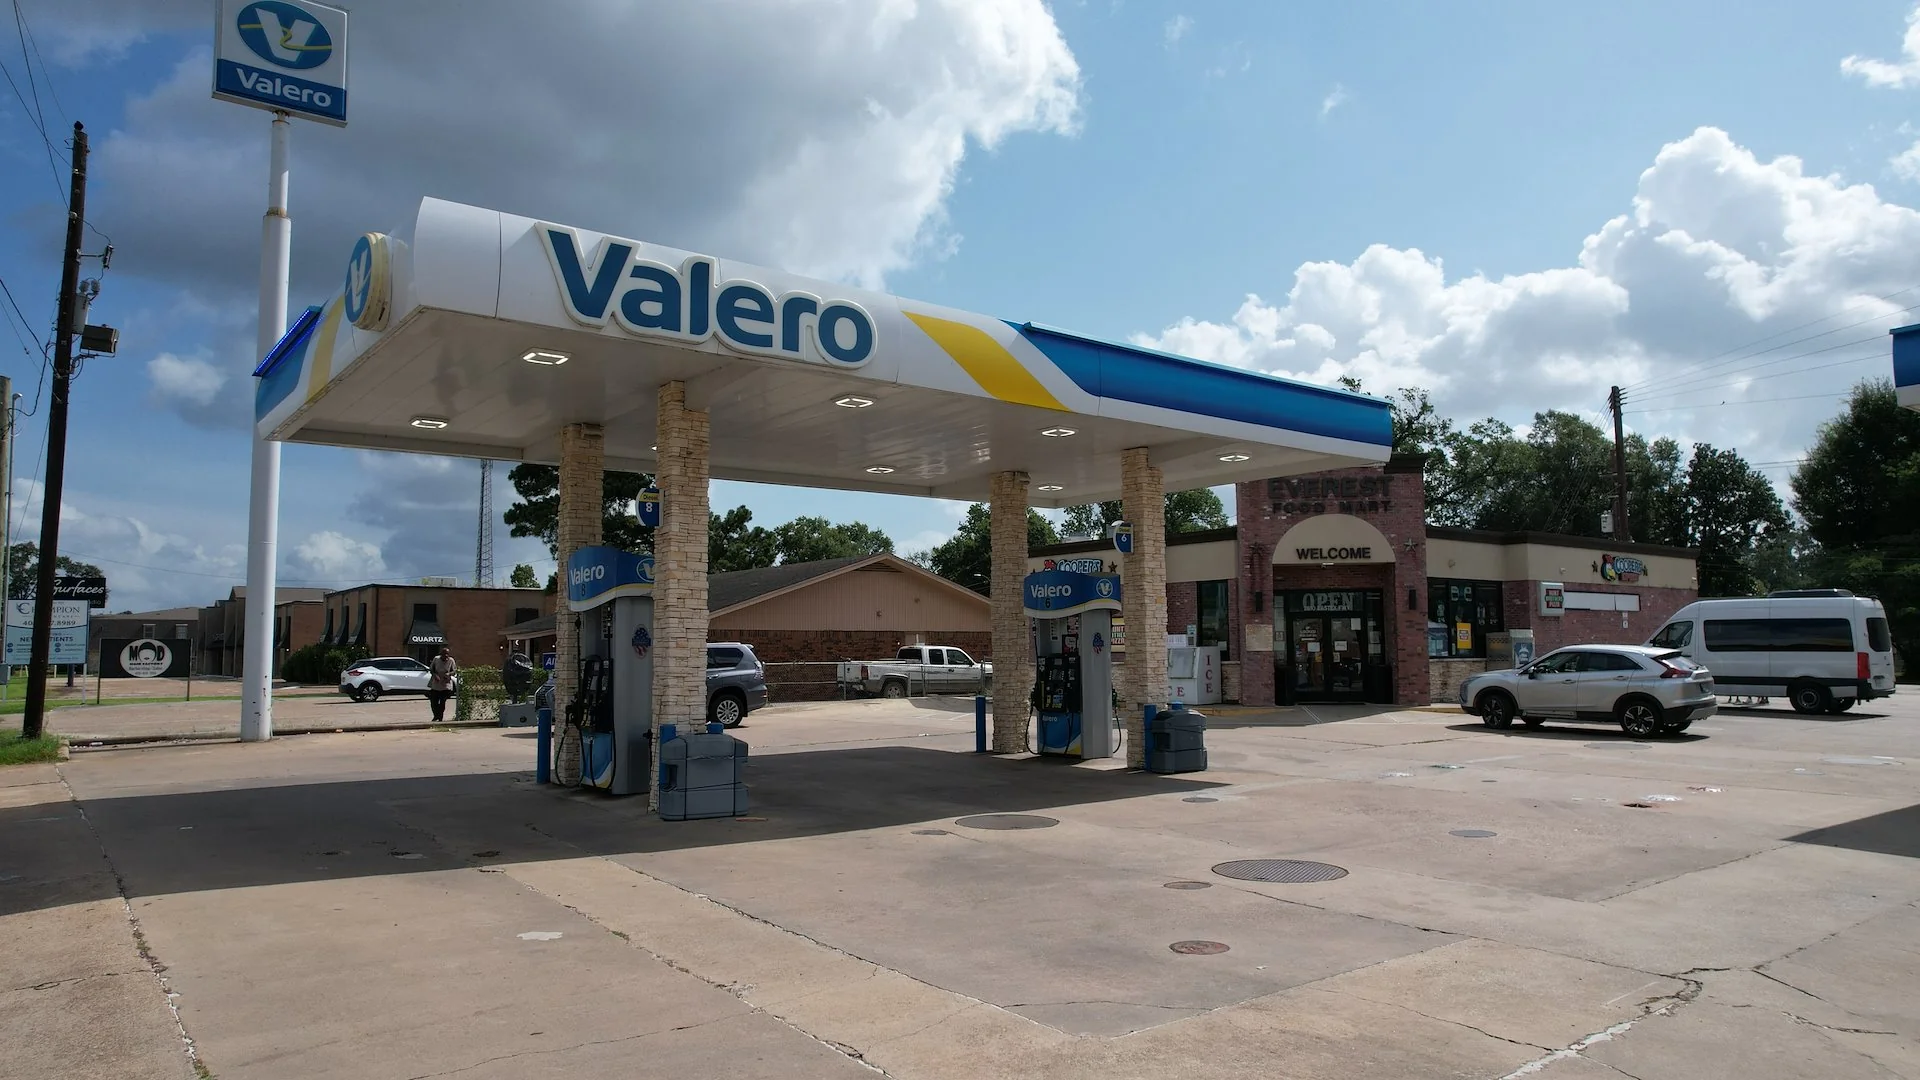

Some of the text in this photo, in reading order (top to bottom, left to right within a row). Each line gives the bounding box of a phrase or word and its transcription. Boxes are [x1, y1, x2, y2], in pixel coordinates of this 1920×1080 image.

[236, 67, 332, 107] Valero
[548, 228, 874, 363] Valero
[1268, 477, 1394, 499] EVEREST
[646, 502, 653, 512] 8
[1273, 500, 1391, 513] FOOD MART
[1121, 533, 1127, 542] 6
[1296, 547, 1371, 561] WELCOME
[570, 564, 605, 586] Valero
[1030, 583, 1072, 598] Valero
[1045, 598, 1051, 608] 6
[1303, 592, 1354, 608] OPEN
[412, 635, 444, 643] QUARTZ
[1205, 655, 1213, 693] ICE
